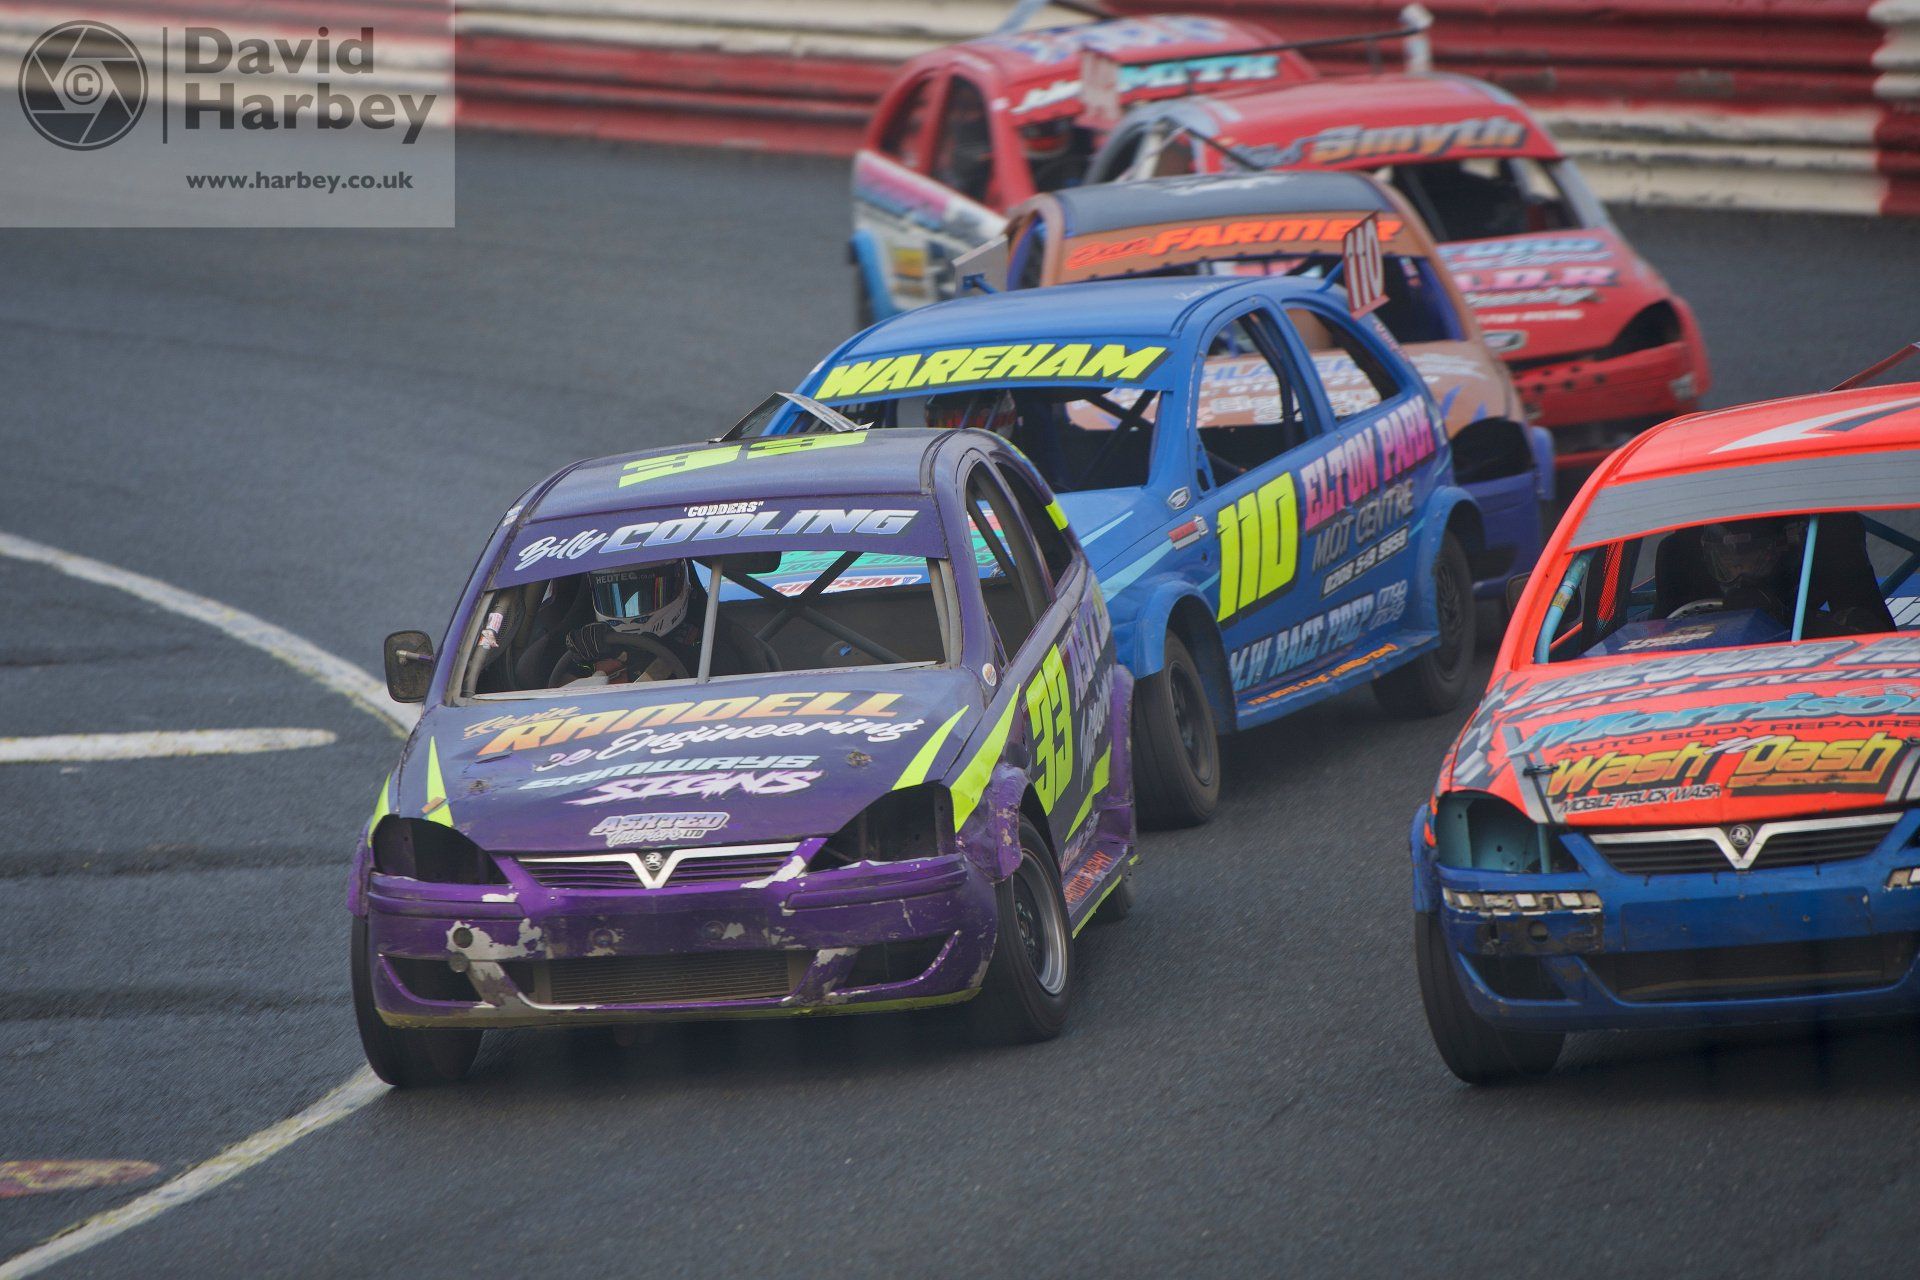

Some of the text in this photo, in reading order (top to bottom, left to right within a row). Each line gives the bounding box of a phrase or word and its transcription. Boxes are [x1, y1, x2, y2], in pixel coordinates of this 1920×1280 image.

[1345, 217, 1384, 310] 110
[814, 343, 1168, 400] WAREHAM
[1301, 395, 1436, 533] ELTON PARK
[514, 508, 920, 571] Billy CODLING
[1216, 471, 1297, 623] 110
[1269, 615, 1325, 678] RACE
[1708, 668, 1920, 690] ENGIN
[477, 693, 904, 756] RANDELL
[595, 718, 925, 761] Engineering
[1026, 642, 1074, 817] 33
[1661, 724, 1760, 742] BODY
[518, 755, 820, 790] SAMWAYS
[565, 769, 823, 806] SIGNS
[1547, 741, 1714, 797] Wash
[1732, 731, 1904, 779] Dash
[1559, 783, 1721, 814] MOBILE TRUCK WASH
